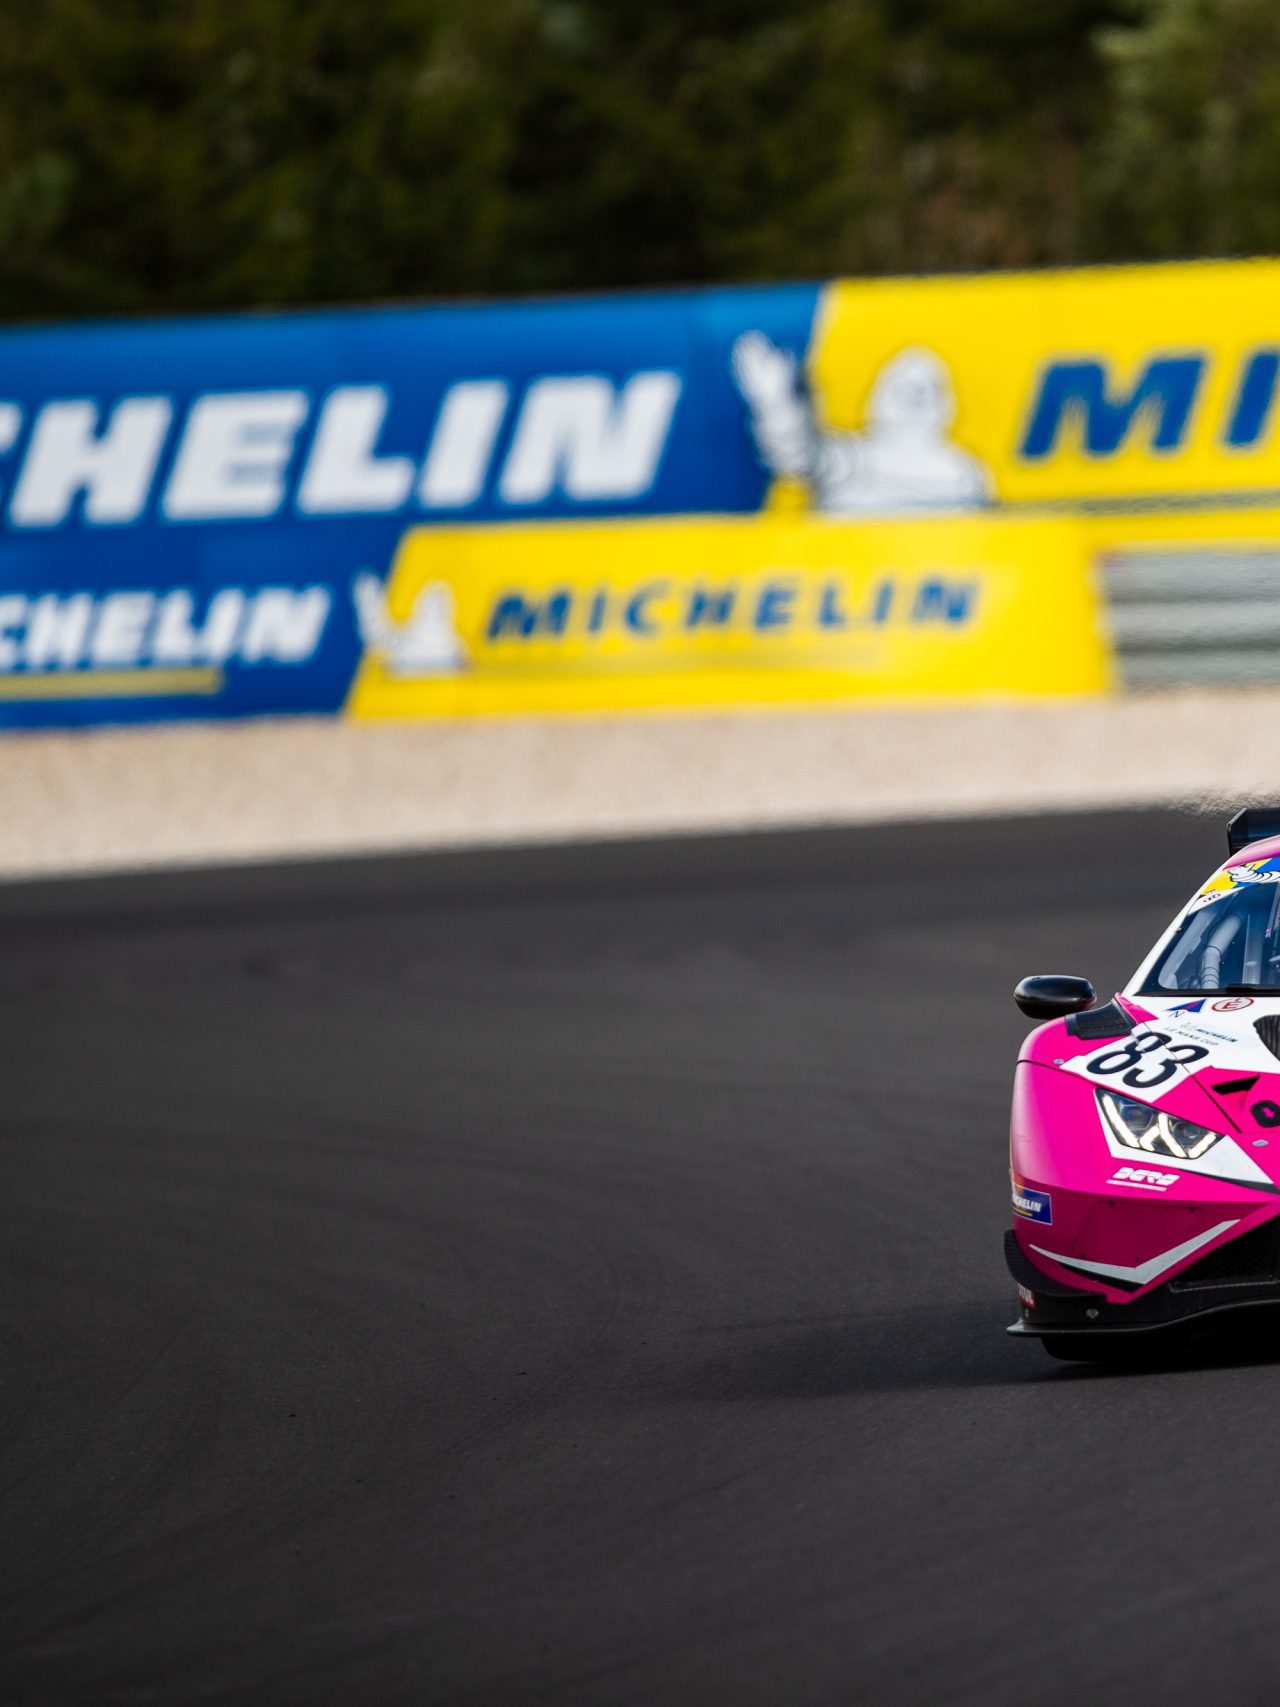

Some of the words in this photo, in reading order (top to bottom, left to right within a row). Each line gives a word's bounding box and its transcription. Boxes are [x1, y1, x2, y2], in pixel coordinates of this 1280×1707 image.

[0, 372, 682, 527] HELIN
[486, 574, 982, 642] MICHELIN
[1086, 1031, 1210, 1089] 83
